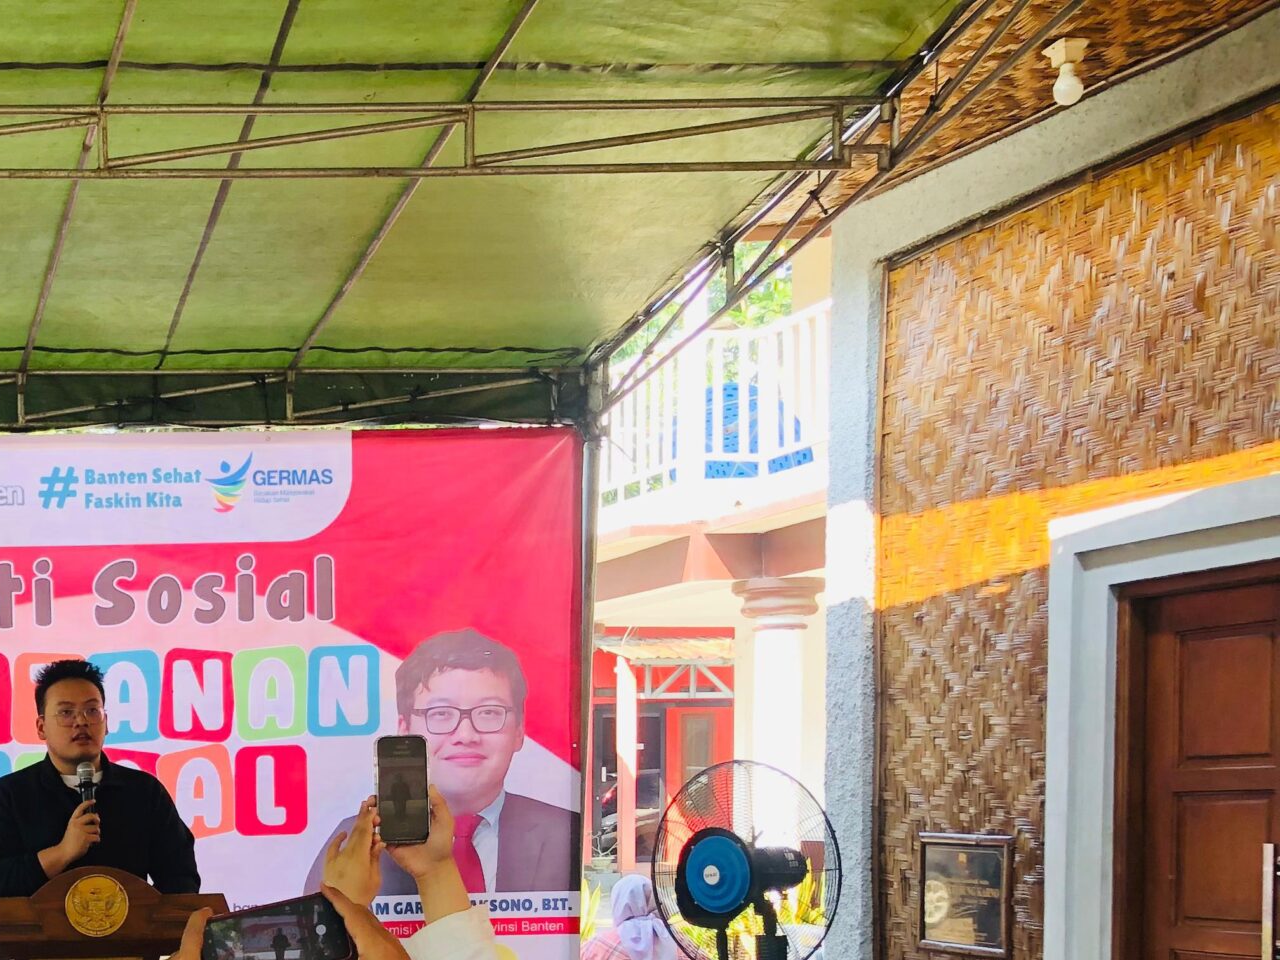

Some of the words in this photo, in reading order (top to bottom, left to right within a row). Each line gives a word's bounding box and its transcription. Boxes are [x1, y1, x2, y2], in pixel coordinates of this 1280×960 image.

[85, 469, 147, 485] Banten
[152, 467, 201, 484] Sehat
[252, 469, 333, 486] GERMAS
[85, 492, 141, 508] Faskin
[146, 491, 182, 508] Kita
[93, 554, 336, 629] Sosial
[542, 897, 573, 911] BIT.
[521, 919, 564, 932] Banten
